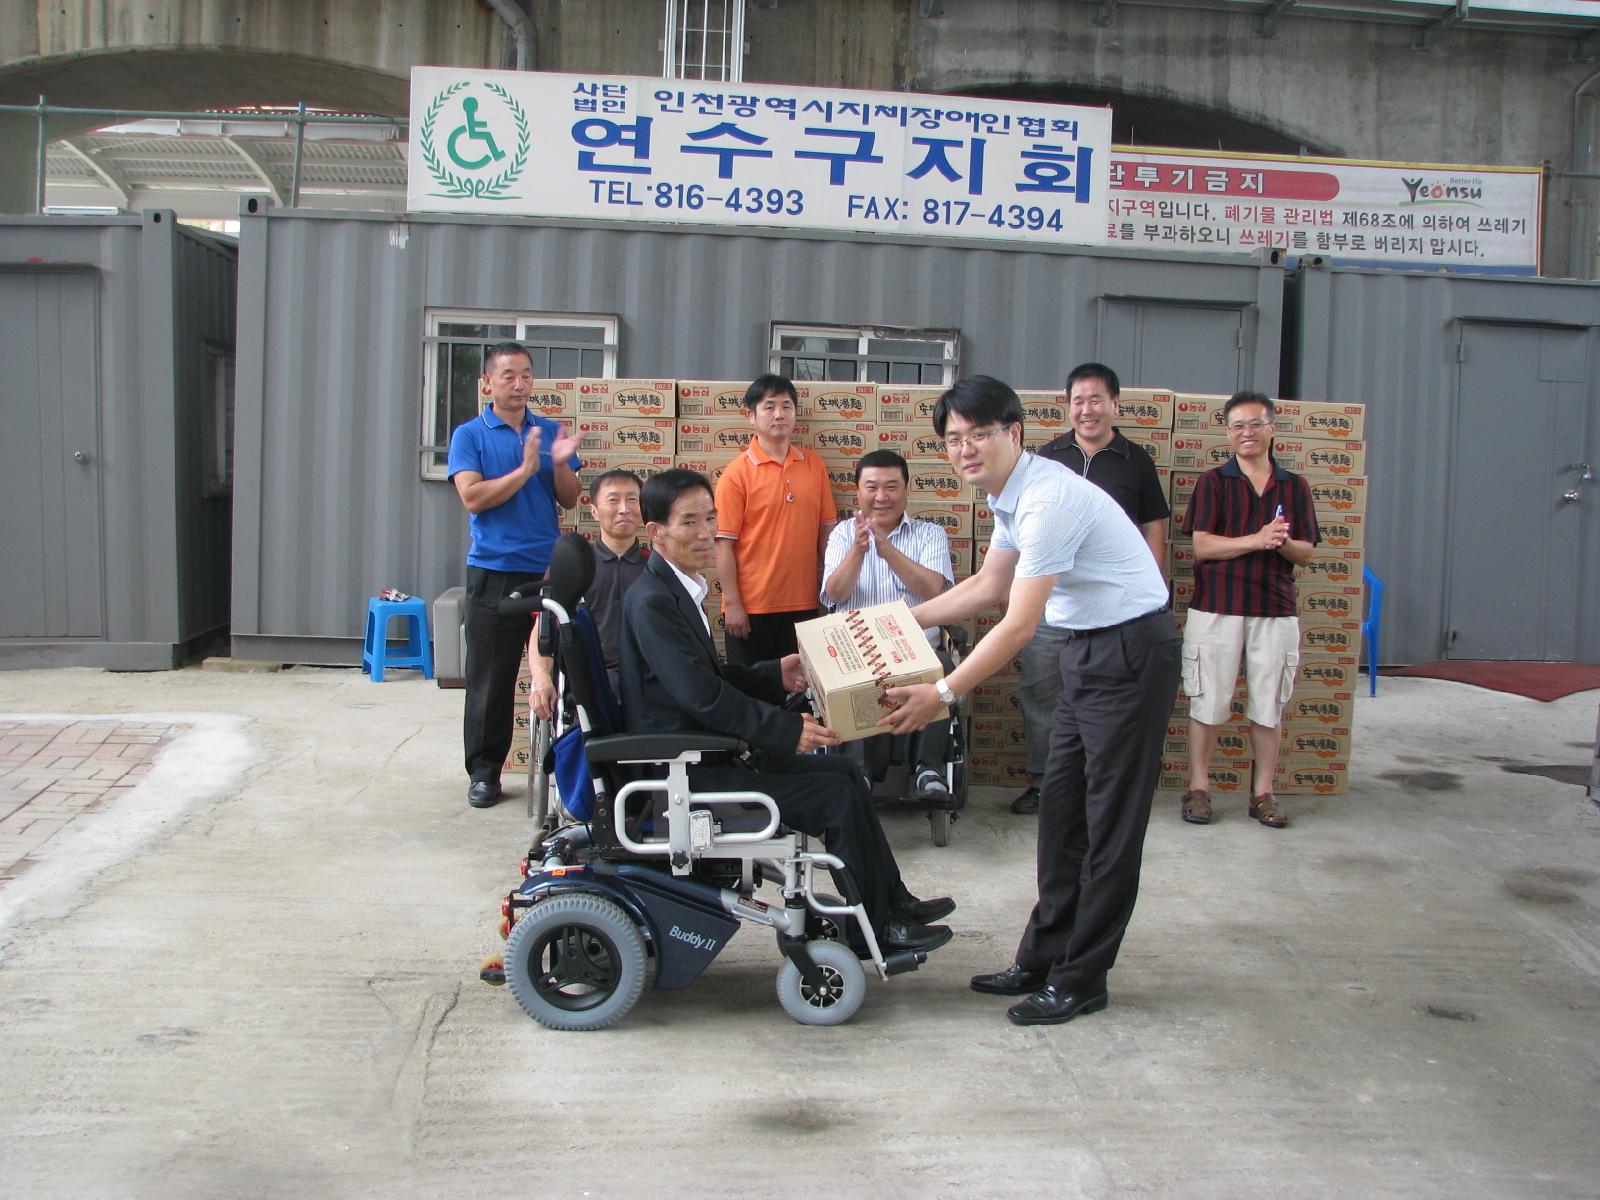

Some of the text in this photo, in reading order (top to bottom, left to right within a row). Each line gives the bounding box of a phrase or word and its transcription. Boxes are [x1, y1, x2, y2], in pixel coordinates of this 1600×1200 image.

[573, 82, 628, 98] 사단
[574, 98, 626, 113] 법인
[571, 115, 1094, 204] 연수구지회
[1401, 177, 1482, 203] Yeonsu
[848, 194, 1064, 232] FAX: 817-4394
[1224, 205, 1276, 225] 폐기물
[1283, 207, 1333, 227] 관리법
[1342, 211, 1414, 230] 제68조에
[1422, 214, 1470, 233] 의하여
[1477, 217, 1526, 235] 쓰레기
[1143, 224, 1230, 245] 부과하오니
[1239, 229, 1308, 249] 쓰레기를
[1316, 232, 1366, 251] 함부로
[1374, 235, 1423, 255] 버리지
[669, 925, 705, 949] Buddy
